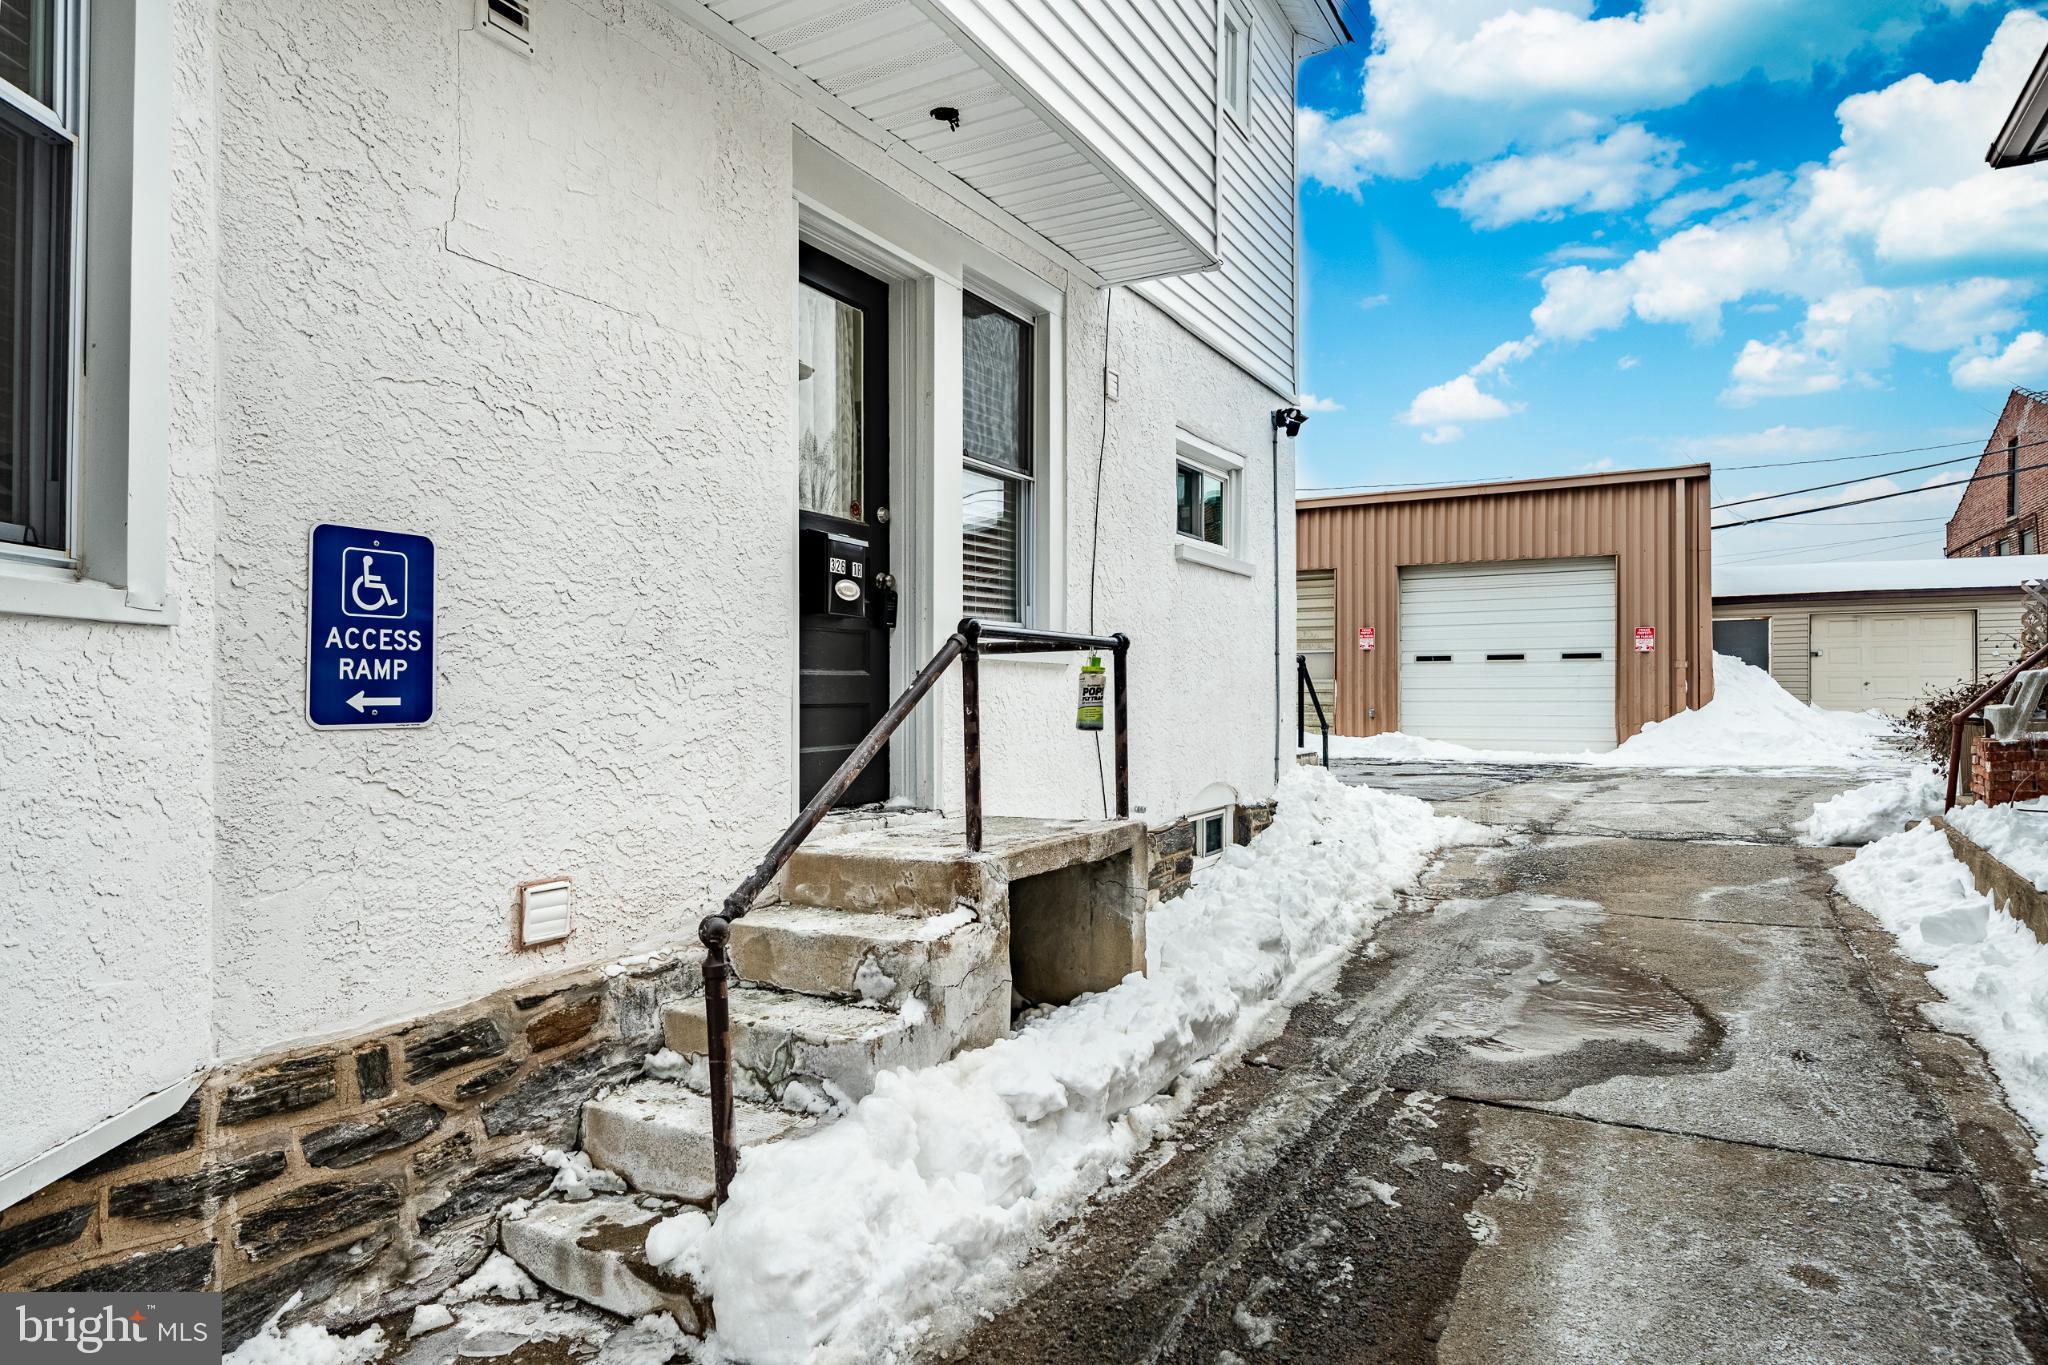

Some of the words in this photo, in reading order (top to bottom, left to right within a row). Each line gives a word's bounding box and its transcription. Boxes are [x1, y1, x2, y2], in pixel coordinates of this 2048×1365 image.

[830, 558, 846, 574] 326
[325, 626, 421, 651] ACCESS
[339, 658, 408, 680] RAMP
